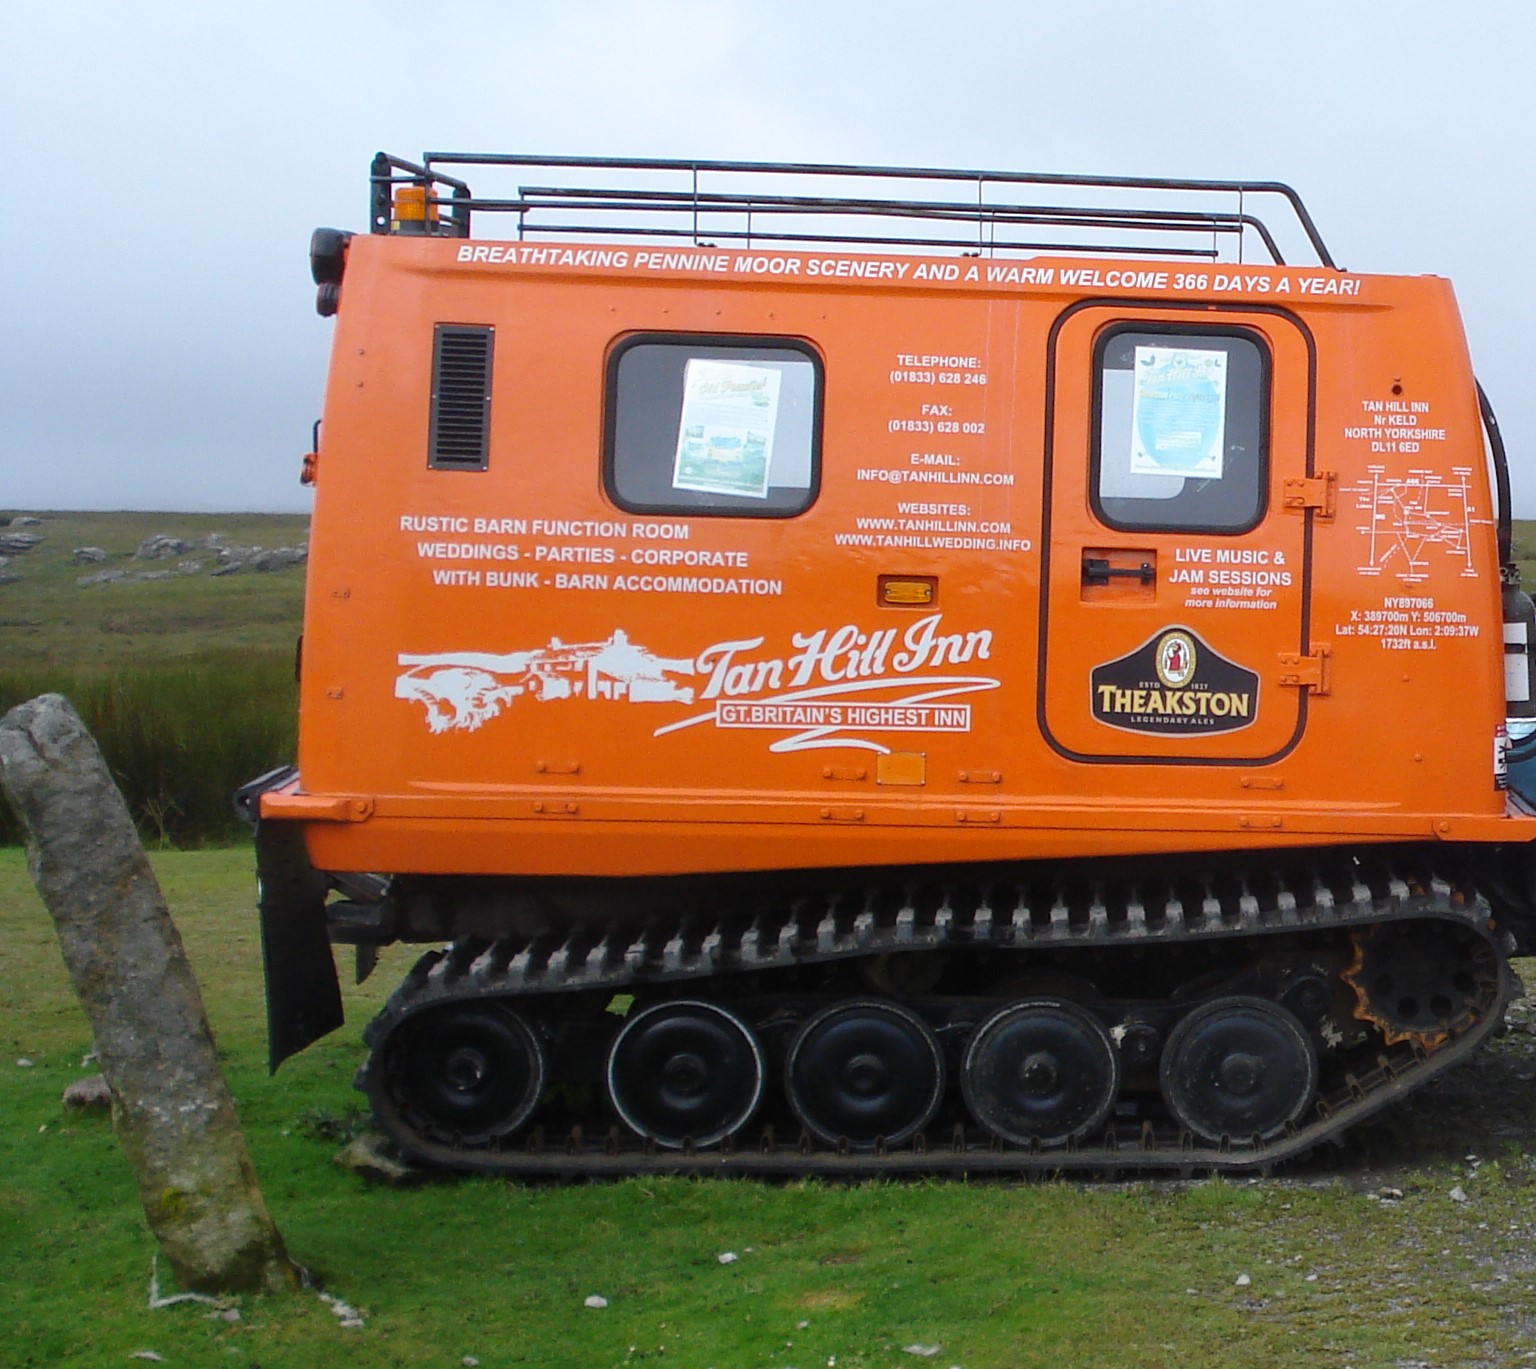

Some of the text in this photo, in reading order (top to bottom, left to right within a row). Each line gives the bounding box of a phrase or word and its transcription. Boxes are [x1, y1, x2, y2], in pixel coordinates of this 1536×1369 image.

[457, 244, 1360, 295] BREATHTAKING PENNINE MOOR SCENERY AND A WARM WELCOME 366 DAYS A YEAR!
[897, 355, 980, 368] TELEPHONE:
[890, 371, 986, 385] (01833) 628 246
[922, 405, 952, 416] FAX:
[1362, 401, 1428, 412] TAN HILL INN
[1374, 415, 1416, 425] Nr KELD
[889, 420, 984, 434] (01833) 628 002
[1345, 428, 1445, 440] NORTH YORKSHIRE
[1372, 442, 1419, 452] DL11 6ED
[911, 454, 959, 465] E-MAIL:
[857, 469, 1013, 485] INFO@TANHILLINN.COM
[898, 503, 970, 515] WEBSITES:
[401, 516, 689, 539] RUSTIC BARN FUNCTION ROOM
[857, 518, 1010, 533] WWW.TANHILLINN.COM
[835, 532, 1031, 551] WWW.TANHILLWEDDING.INFO
[418, 542, 518, 560] WEDDINGS
[535, 546, 615, 563] PARTIES
[631, 549, 748, 567] CORPORATE
[1176, 549, 1285, 564] LIVE MUSIC &
[433, 570, 480, 585] WITH
[486, 571, 538, 587] BUNK
[555, 573, 608, 589] BARN
[613, 575, 782, 594] ACCOMMODATION
[1169, 570, 1291, 585] JAM SESSIONS
[1191, 586, 1272, 596] see website for
[1185, 598, 1277, 609] more information
[1351, 611, 1466, 622] X: 389700m Y: 506700m
[1336, 624, 1479, 636] Lat: 54:27:20N Lon: 2:09:37W
[1381, 638, 1436, 649] 1732ft a.s.l.
[697, 614, 993, 699] Tan Hill Inn
[1098, 685, 1249, 717] THEAKSTON
[721, 706, 966, 727] GT.BRITAIN'S HIGHEST INN
[1131, 716, 1188, 724] LEGENDARY
